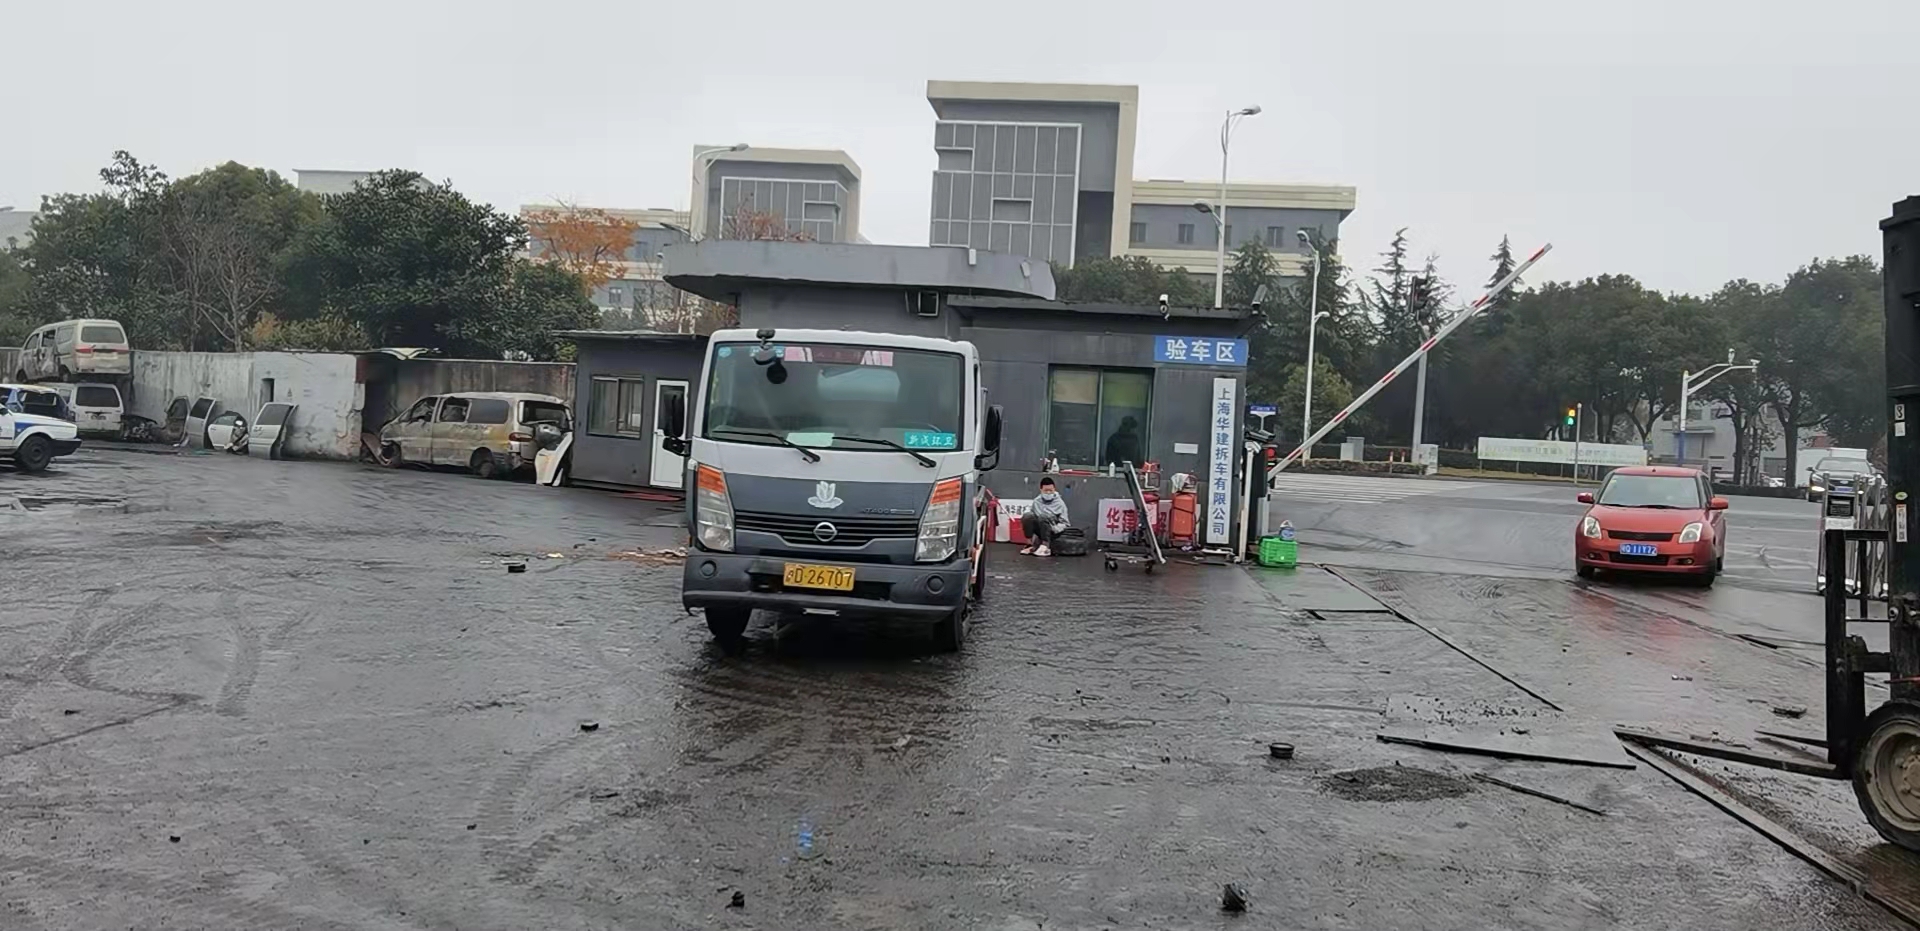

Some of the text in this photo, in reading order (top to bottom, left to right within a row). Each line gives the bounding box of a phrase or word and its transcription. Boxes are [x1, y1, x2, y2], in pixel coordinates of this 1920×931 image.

[1164, 338, 1236, 363] 验车区
[1212, 387, 1231, 536] 上海华建拆车有限公司
